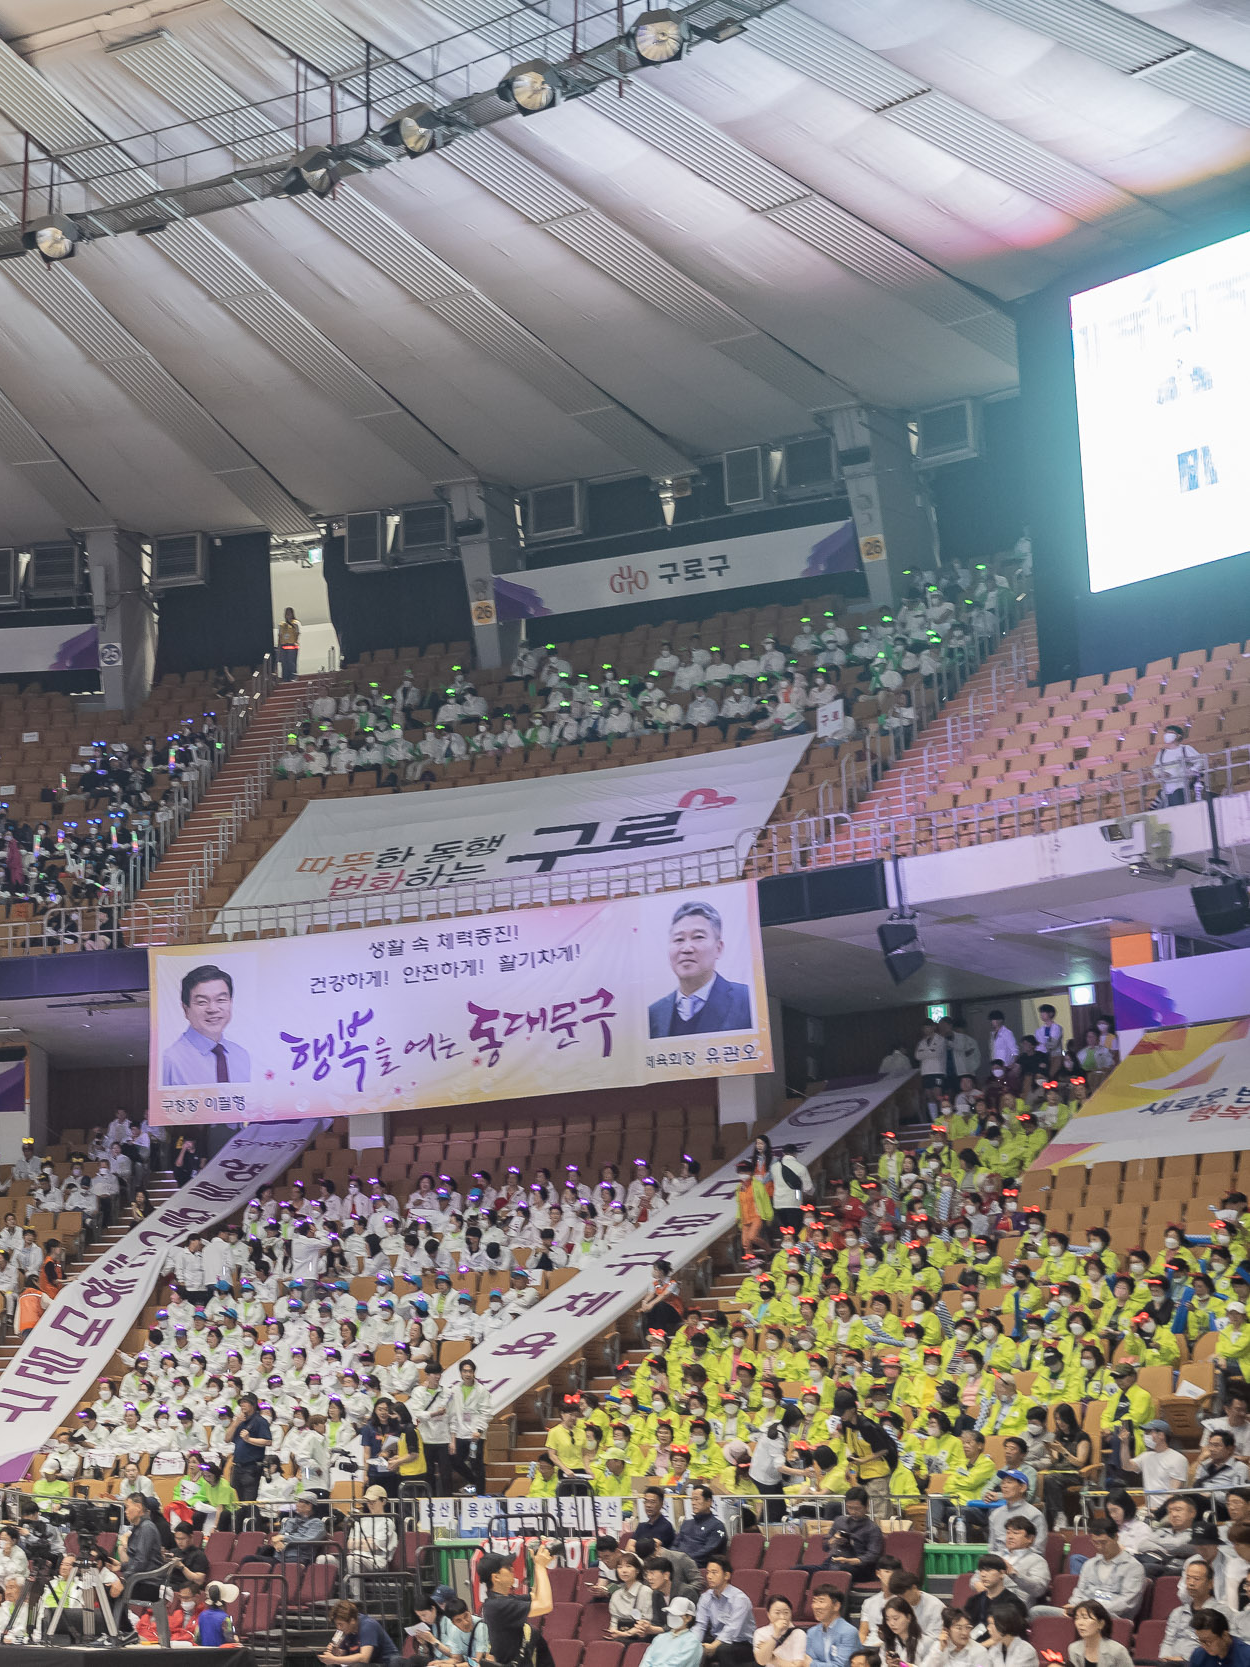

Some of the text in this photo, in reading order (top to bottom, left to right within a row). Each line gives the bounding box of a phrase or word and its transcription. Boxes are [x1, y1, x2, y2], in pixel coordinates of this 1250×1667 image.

[864, 540, 882, 557] 26
[658, 553, 731, 584] 구로구
[476, 604, 493, 620] 26
[102, 648, 119, 663] 25
[295, 834, 507, 875] 따뜻한 동행
[506, 811, 684, 873] 구로
[328, 860, 487, 898] 변화하는
[368, 924, 519, 959] 생활 속 체력증진!
[309, 943, 581, 995] 건강하게! 안전하게! 활기차게!
[279, 987, 618, 1093] 행복을 여는 동대문구
[705, 1043, 758, 1064] 유관오
[161, 1094, 247, 1114] 구청장 이필형
[467, 1502, 493, 1518] 용산
